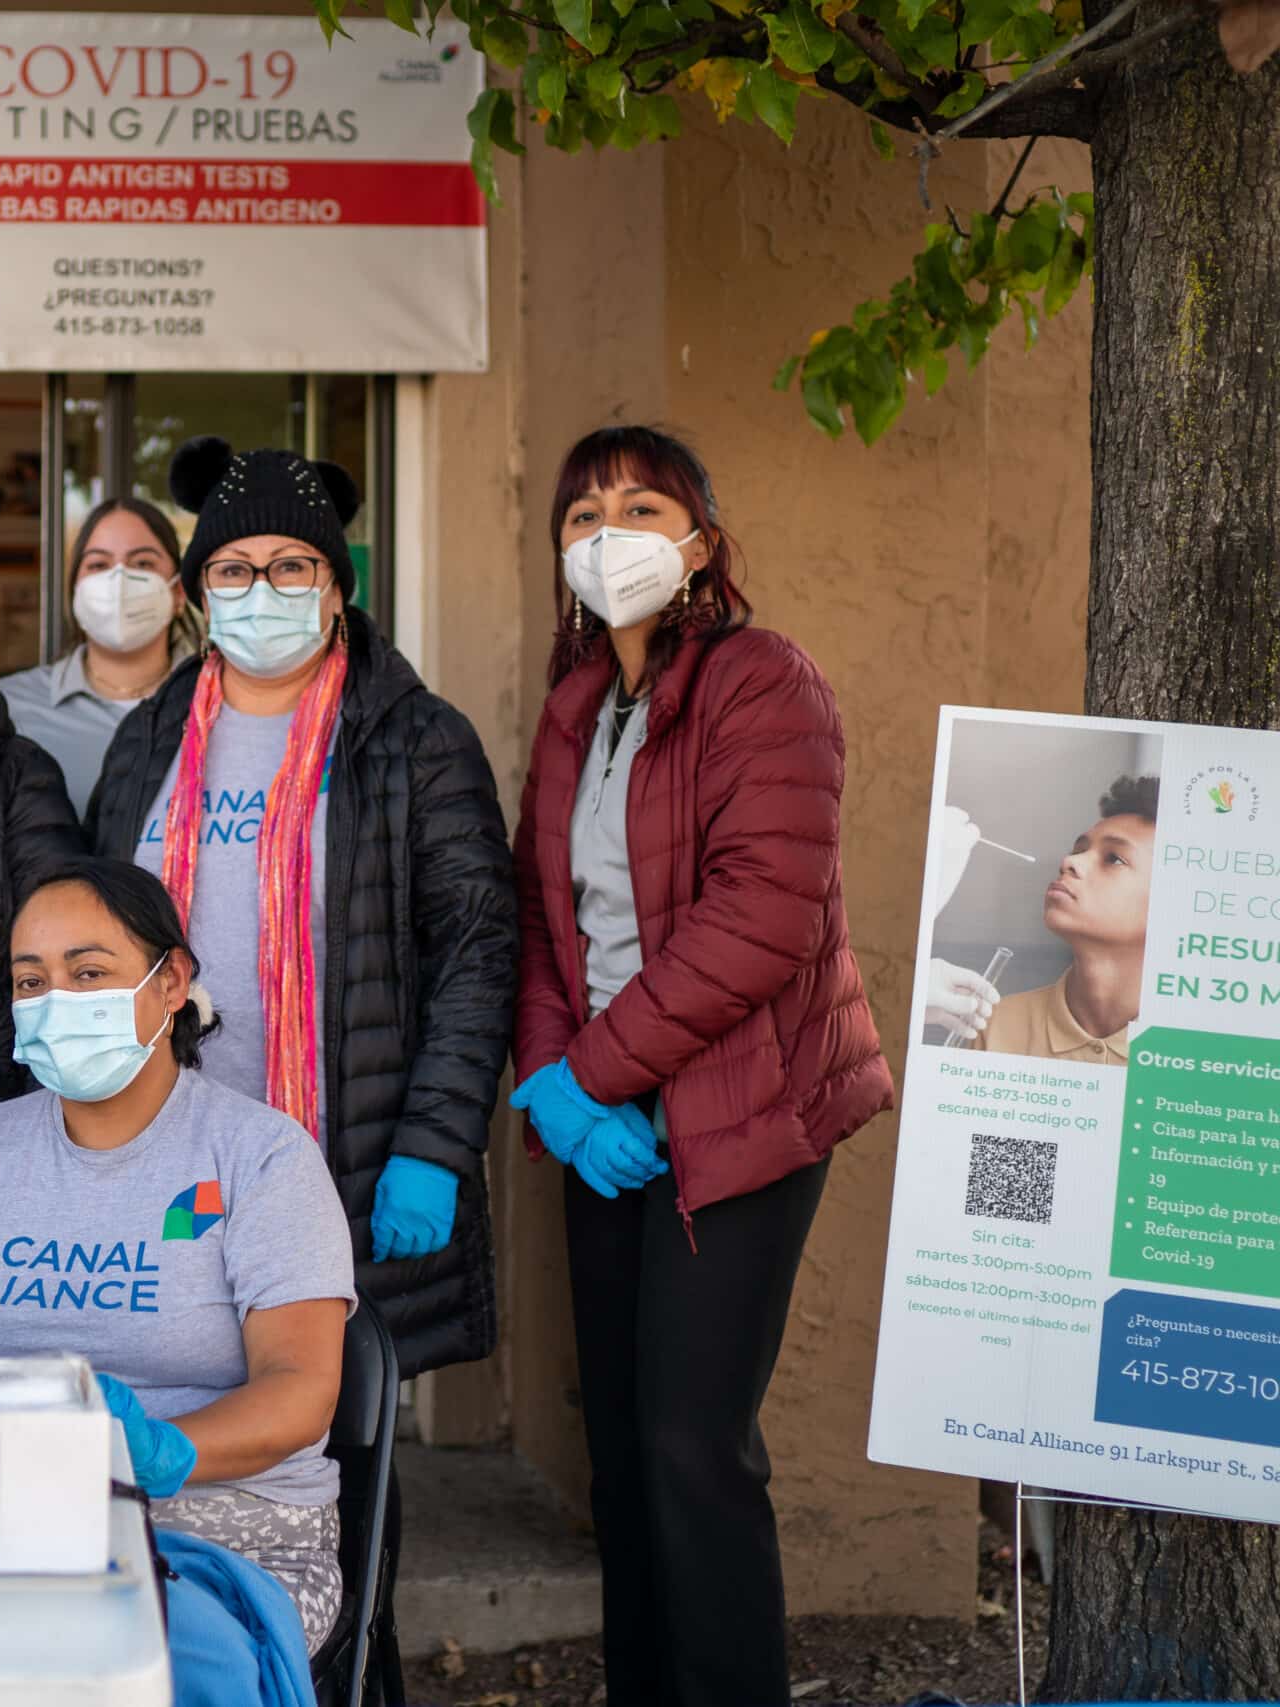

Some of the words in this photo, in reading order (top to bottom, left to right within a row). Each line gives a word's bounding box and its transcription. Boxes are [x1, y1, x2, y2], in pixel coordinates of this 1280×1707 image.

[68, 164, 195, 190] ANTIGEN
[202, 165, 289, 190] TESTS
[65, 196, 186, 222] RAPIDAS
[193, 198, 341, 223] ANTIGENO
[53, 257, 204, 279] QUESTIONS?
[43, 286, 215, 310] ¿PREGUNTAS?
[53, 317, 204, 337] 415-873-1058
[1194, 890, 1238, 917] DE
[1156, 973, 1199, 998] EN
[1209, 978, 1249, 1003] 30
[940, 1063, 973, 1078] Para
[977, 1067, 1005, 1081] una
[1009, 1070, 1037, 1085] cita
[1040, 1073, 1082, 1090] llame
[1086, 1080, 1100, 1091] al
[1137, 1050, 1196, 1071] Otros
[1200, 1058, 1280, 1081] servicio
[963, 1085, 1058, 1106] 415-873-1058
[1061, 1098, 1071, 1108] o
[1155, 1096, 1222, 1118] Pruebas
[1226, 1106, 1264, 1122] para
[937, 1103, 998, 1119] escanea
[1002, 1108, 1015, 1120] el
[1019, 1110, 1071, 1128] codigo
[1074, 1117, 1098, 1131] QR
[1152, 1122, 1196, 1139] Citas
[1199, 1129, 1238, 1145] para
[1241, 1131, 1256, 1146] la
[1151, 1146, 1254, 1171] Información
[1257, 1161, 1268, 1176] y
[1148, 1173, 1166, 1188] 19
[1147, 1196, 1205, 1218] Equipo
[1208, 1204, 1229, 1218] de
[1232, 1210, 1280, 1226] prote
[971, 1229, 997, 1245] Sin
[1001, 1232, 1035, 1249] cita:
[1144, 1221, 1233, 1245] Referencia
[1236, 1235, 1275, 1250] para
[2, 1236, 159, 1273] CANAL
[916, 1248, 968, 1265] martes
[971, 1254, 1092, 1281] 3:00pm-5:00pm
[1142, 1246, 1215, 1270] Covid-19
[906, 1274, 968, 1293] sábados
[970, 1281, 1097, 1310] 12:00pm-3:00pm
[907, 1299, 960, 1318] (excepto
[964, 1307, 975, 1318] el
[1022, 1315, 1069, 1331] sábado
[1071, 1320, 1091, 1334] del
[1127, 1314, 1210, 1335] ¿Preguntas
[1213, 1327, 1222, 1337] o
[980, 1333, 1012, 1348] mes)
[1126, 1334, 1161, 1348] cita?
[1121, 1359, 1280, 1400] 415-873-10
[944, 1418, 968, 1436] En
[973, 1423, 1025, 1445] Canal
[1029, 1431, 1105, 1457] Alliance
[1109, 1445, 1129, 1461] 91
[1135, 1445, 1222, 1474] Larkspur
